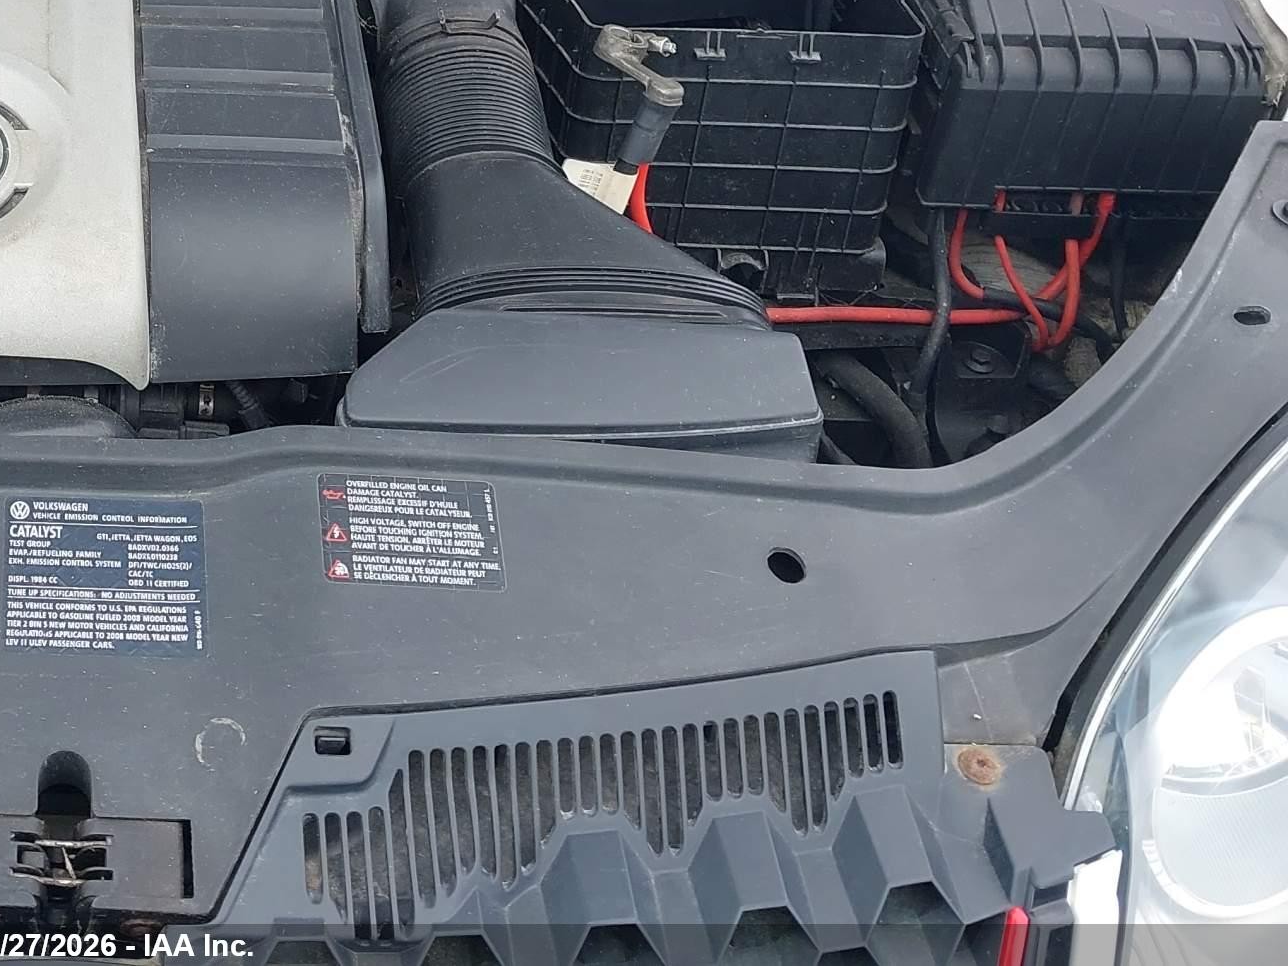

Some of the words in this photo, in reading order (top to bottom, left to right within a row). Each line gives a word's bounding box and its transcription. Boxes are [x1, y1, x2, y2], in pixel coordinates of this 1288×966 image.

[346, 480, 388, 489] OVERFILLED
[380, 490, 415, 498] CATALYST.
[347, 497, 394, 506] REMPLISSAGE
[33, 502, 88, 511] VOLKSWAGEN
[348, 505, 392, 514] DANGEREUX
[425, 509, 472, 518] CATALYSEUR.
[407, 520, 435, 528] SWITCH
[9, 525, 61, 539] CATALYST
[379, 527, 416, 536] TOUCHING
[418, 530, 452, 538] IGNITION
[453, 532, 482, 540] SYSTEM.
[412, 538, 442, 546] ARRÊTER
[454, 540, 484, 548] MOTEUR
[9, 549, 72, 557] EVAP./REFUELING
[390, 544, 423, 553] TOUCHER
[432, 547, 480, 556] L'ALLUMAGE.
[352, 556, 390, 564] RADIATOR
[363, 564, 412, 573] VENTILATEUR
[424, 568, 466, 576] RADIATEUR
[364, 573, 409, 582] DÉCLENCHER
[440, 577, 475, 586] MOMENT.
[40, 590, 95, 598] SPECIFICATIONS:
[114, 592, 164, 600] ADJUSTMENTS
[138, 606, 186, 614] REGULATIONS
[6, 629, 52, 637] REGULATIONS
[49, 640, 89, 648] PASSENGER
